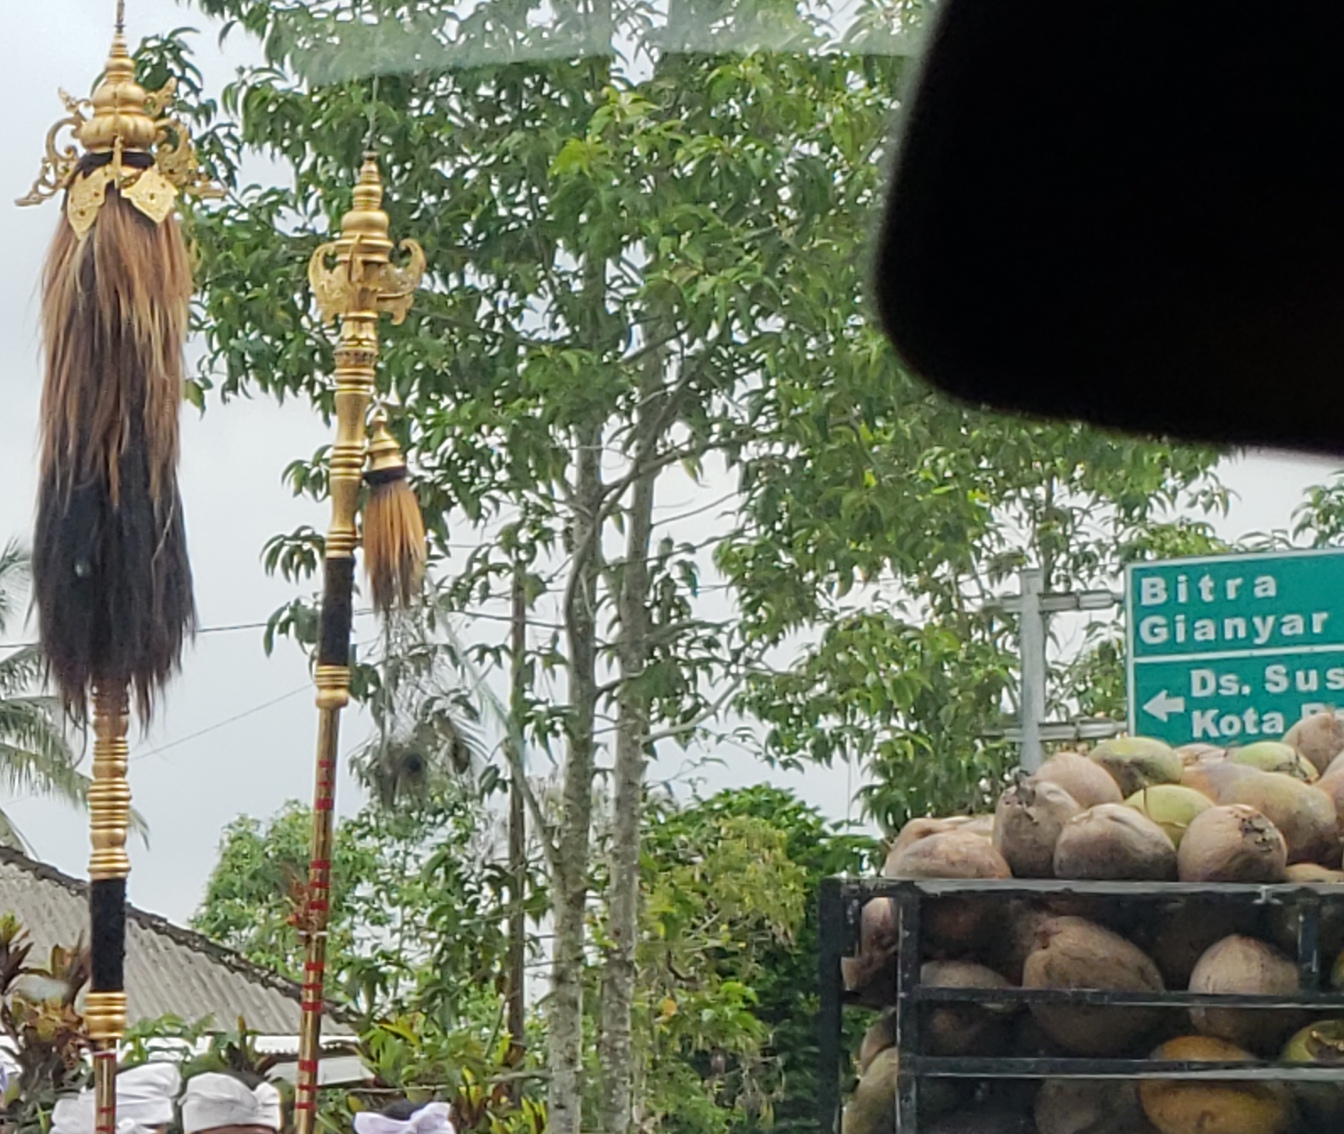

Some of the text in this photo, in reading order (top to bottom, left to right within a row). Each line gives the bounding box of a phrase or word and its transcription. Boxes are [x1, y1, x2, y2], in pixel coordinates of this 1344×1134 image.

[1140, 575, 1277, 606] Bitra
[1139, 612, 1329, 645] Gianyar
[1190, 664, 1344, 698] Ds. Sus
[1192, 707, 1284, 738] Kota
